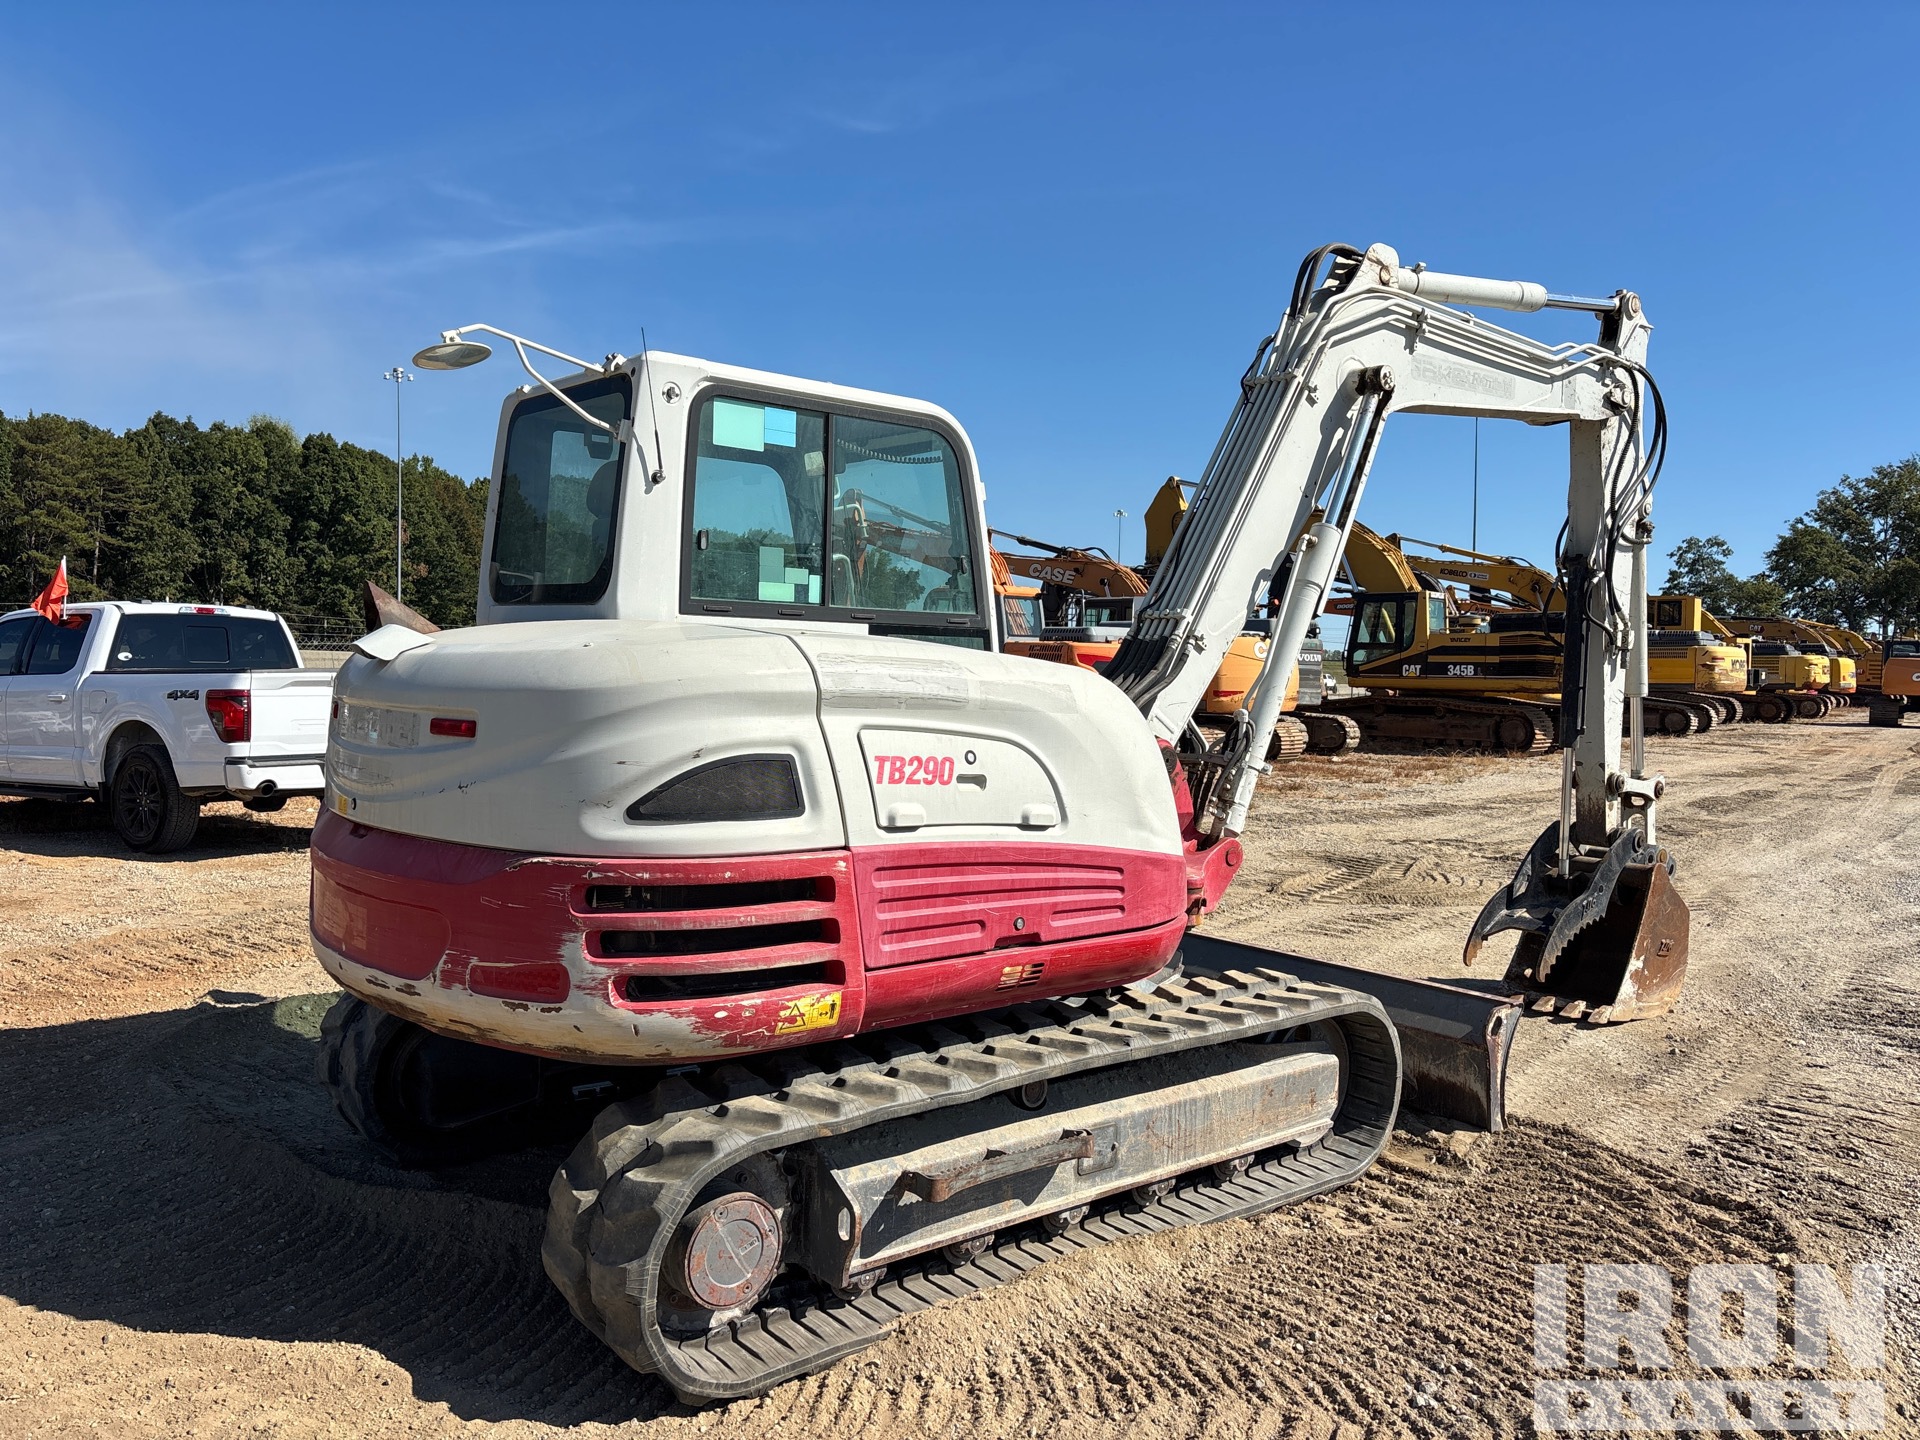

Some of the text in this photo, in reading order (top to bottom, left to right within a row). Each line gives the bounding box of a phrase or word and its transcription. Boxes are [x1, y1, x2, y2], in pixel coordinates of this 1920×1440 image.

[1029, 563, 1076, 584] CASE
[1439, 567, 1468, 577] KOBELCO
[1298, 653, 1321, 662] VOLVO
[1402, 664, 1421, 676] CAT
[1447, 664, 1474, 676] 345B
[874, 755, 955, 786] TB290
